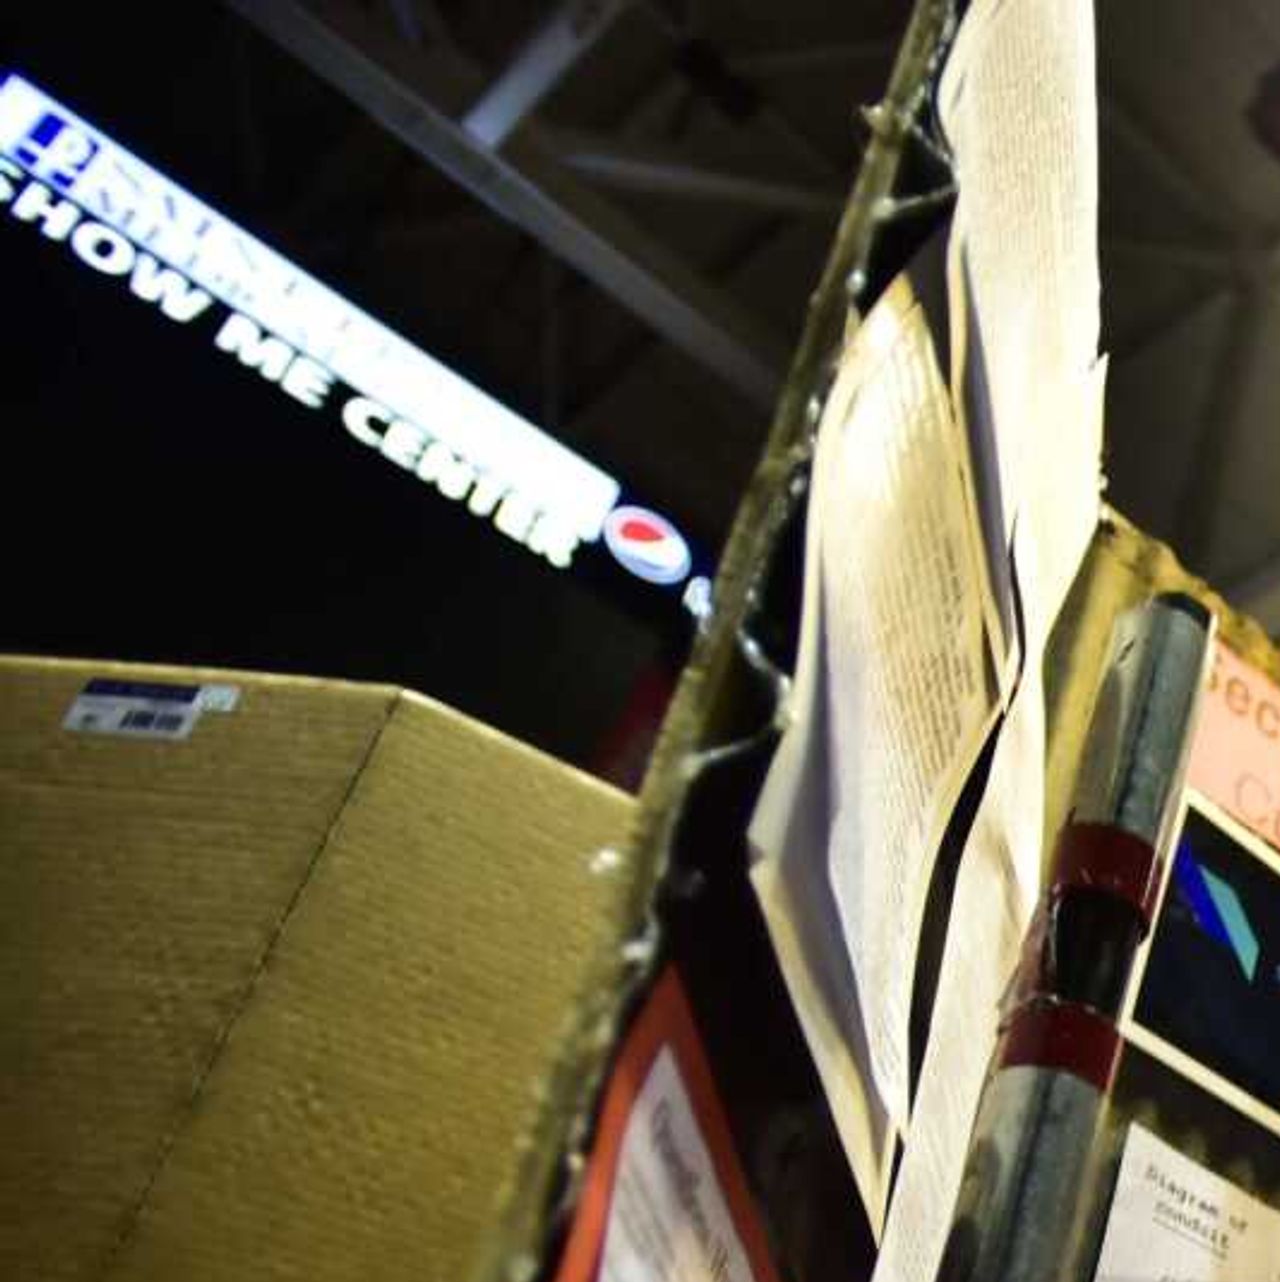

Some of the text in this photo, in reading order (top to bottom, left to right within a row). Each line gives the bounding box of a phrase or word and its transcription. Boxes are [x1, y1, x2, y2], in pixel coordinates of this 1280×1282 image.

[213, 310, 336, 409] ME
[341, 396, 581, 569] CENTER
[1144, 1161, 1220, 1217] Diagram
